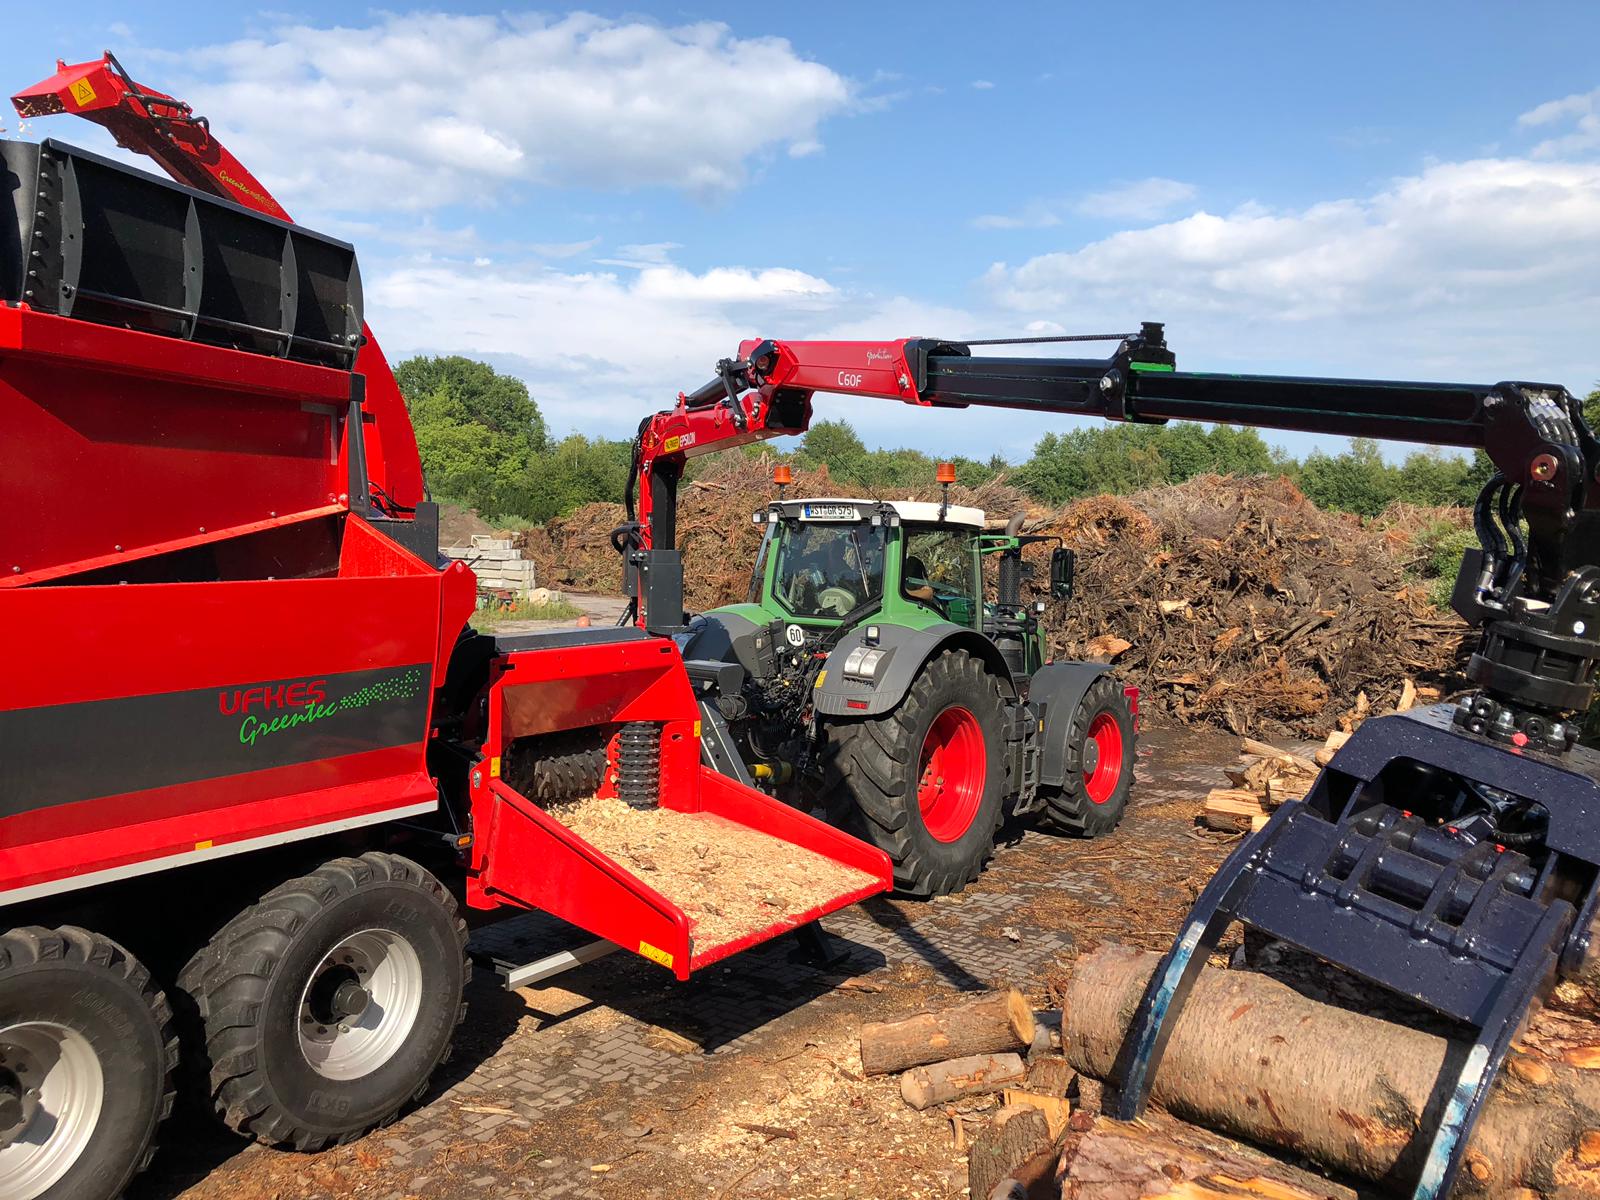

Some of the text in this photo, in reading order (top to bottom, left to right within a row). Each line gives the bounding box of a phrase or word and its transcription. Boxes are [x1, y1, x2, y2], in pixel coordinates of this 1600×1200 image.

[838, 371, 862, 387] C60F
[838, 505, 852, 515] 575
[790, 628, 801, 642] 60
[219, 679, 328, 716] UFKES
[239, 700, 338, 746] Greentec
